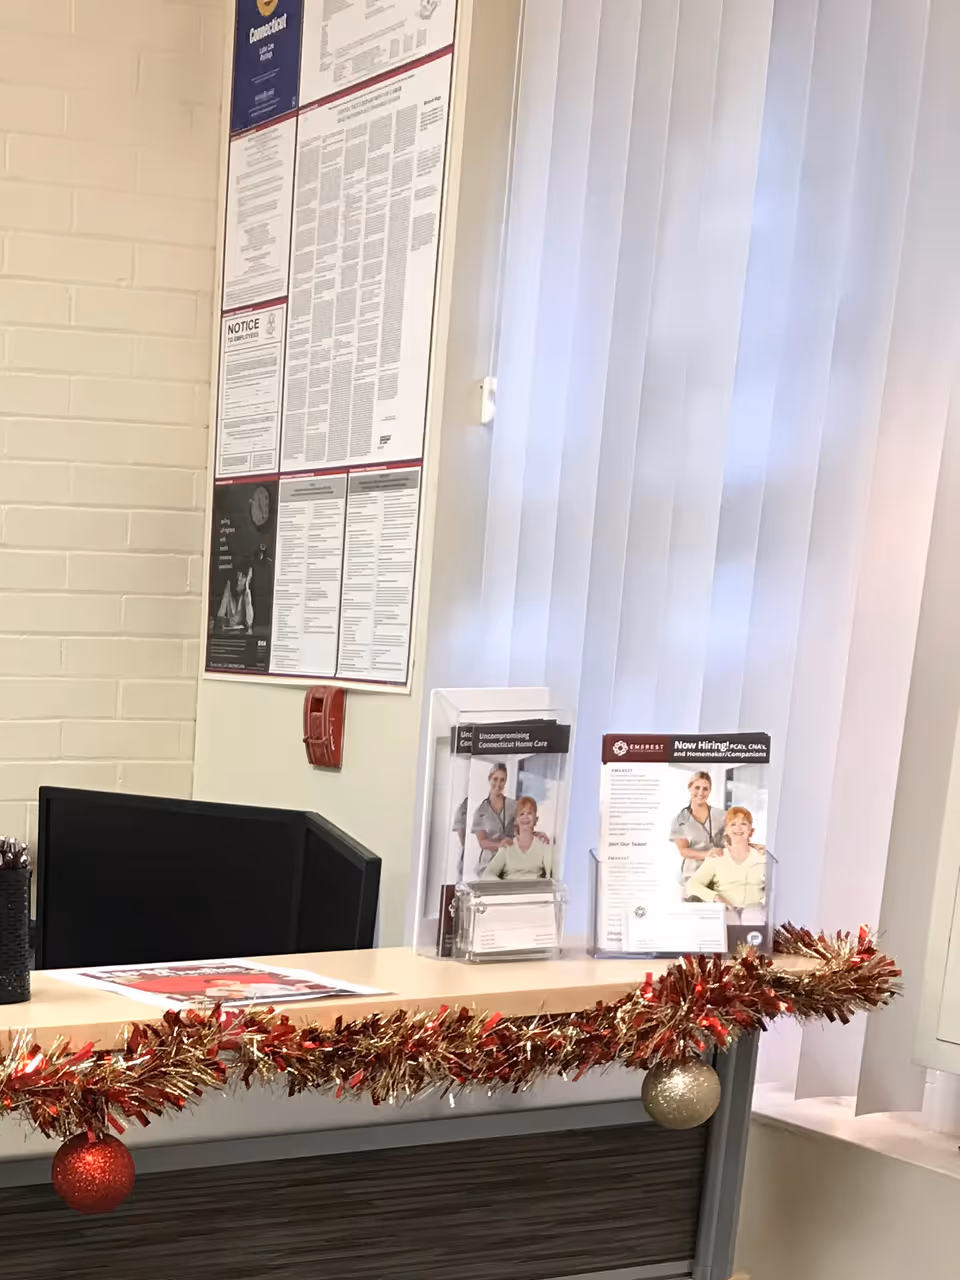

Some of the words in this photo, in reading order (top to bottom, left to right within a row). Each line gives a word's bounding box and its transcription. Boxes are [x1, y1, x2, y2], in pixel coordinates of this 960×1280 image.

[249, 13, 287, 44] Connecticut
[228, 318, 260, 335] NOTICE
[674, 740, 697, 749] Now
[698, 740, 729, 752] Hiring!
